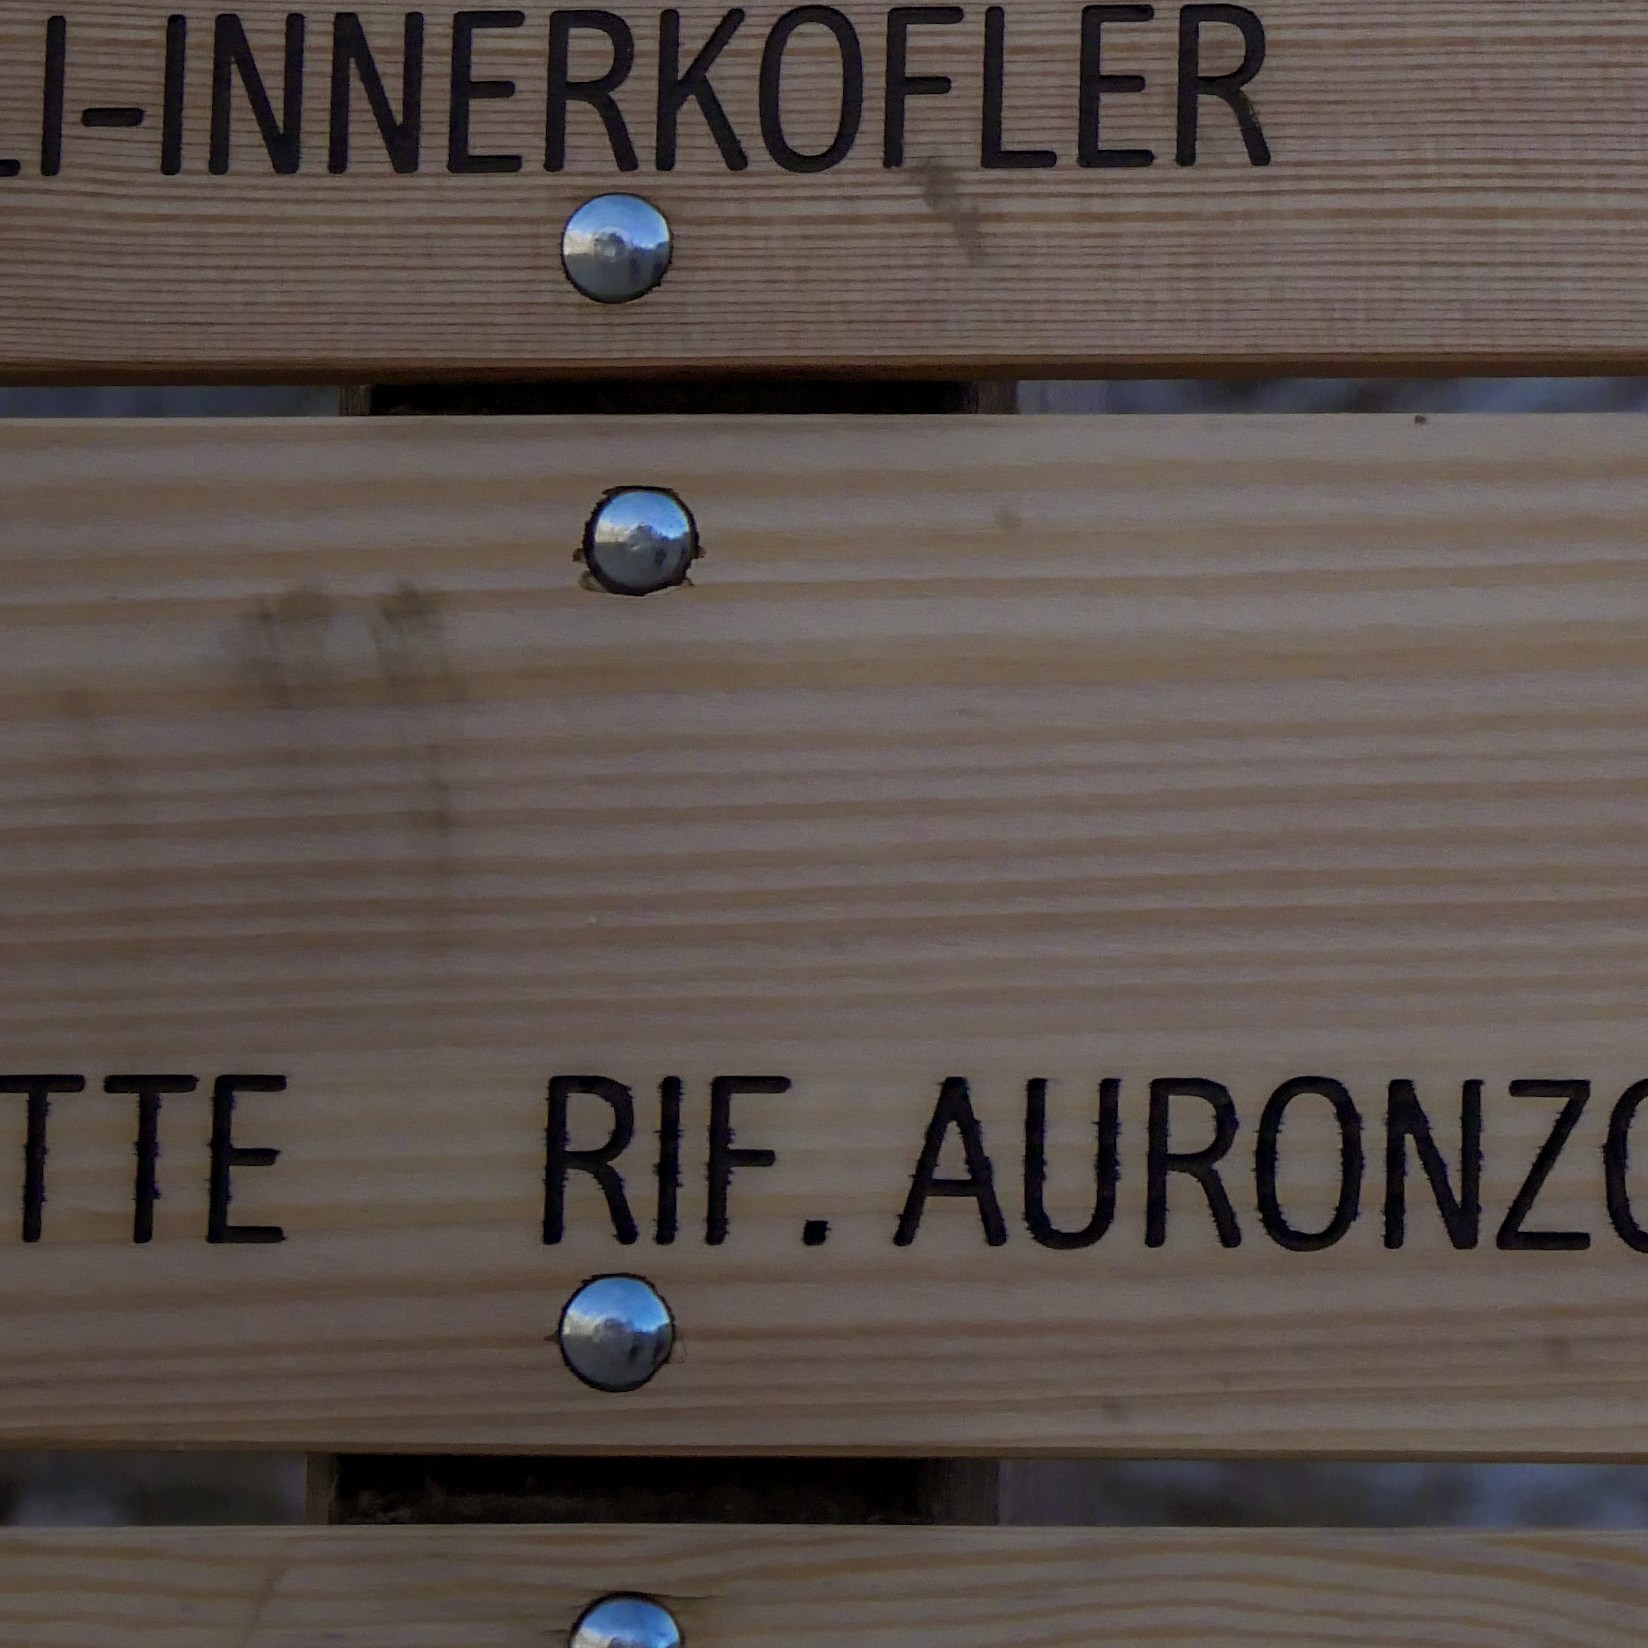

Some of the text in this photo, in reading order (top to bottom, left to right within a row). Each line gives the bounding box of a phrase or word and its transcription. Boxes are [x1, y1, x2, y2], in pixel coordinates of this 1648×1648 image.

[0, 3, 1272, 177] I-INNERKOFLER
[0, 1073, 288, 1245] TTE
[541, 1074, 832, 1247] RIF.
